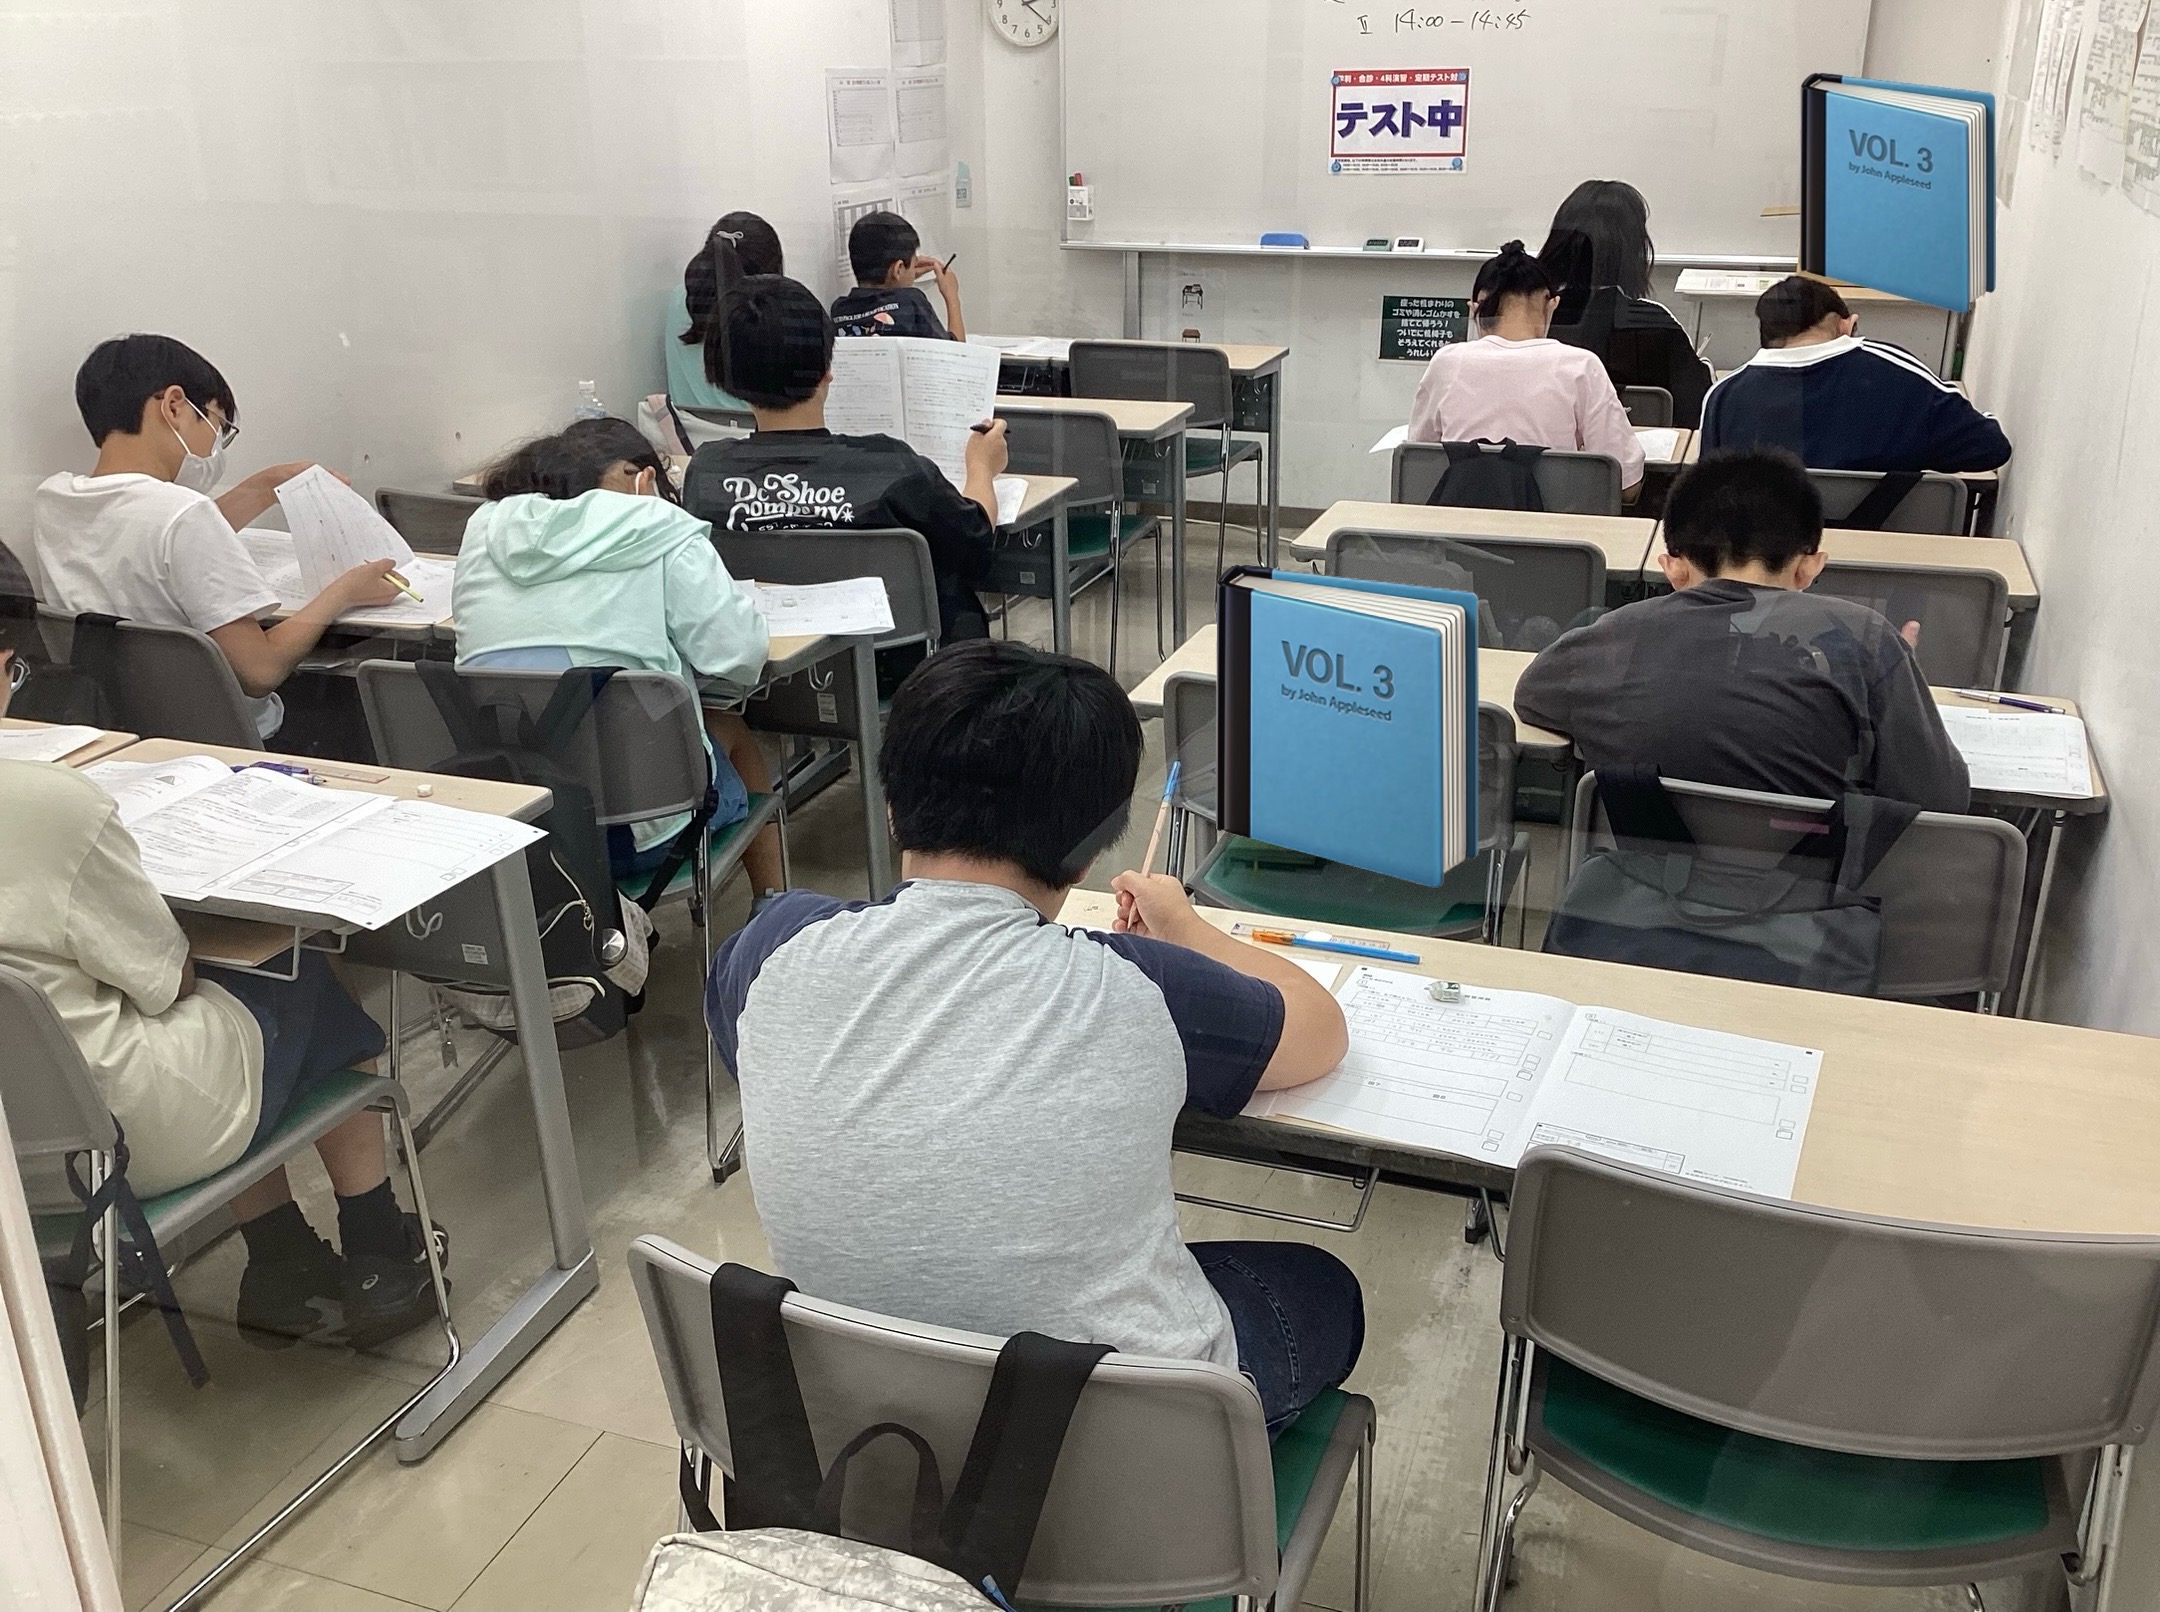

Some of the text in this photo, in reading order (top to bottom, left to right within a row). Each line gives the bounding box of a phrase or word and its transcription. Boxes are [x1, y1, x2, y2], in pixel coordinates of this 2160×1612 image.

[1002, 14, 1008, 24] 8
[1395, 8, 1444, 33] 14:00
[1471, 9, 1532, 31] 14:45
[1012, 24, 1018, 34] 7
[1024, 28, 1030, 38] 6
[1037, 24, 1043, 34] 5
[1336, 99, 1463, 138] テスト中
[763, 473, 846, 504] Shoe
